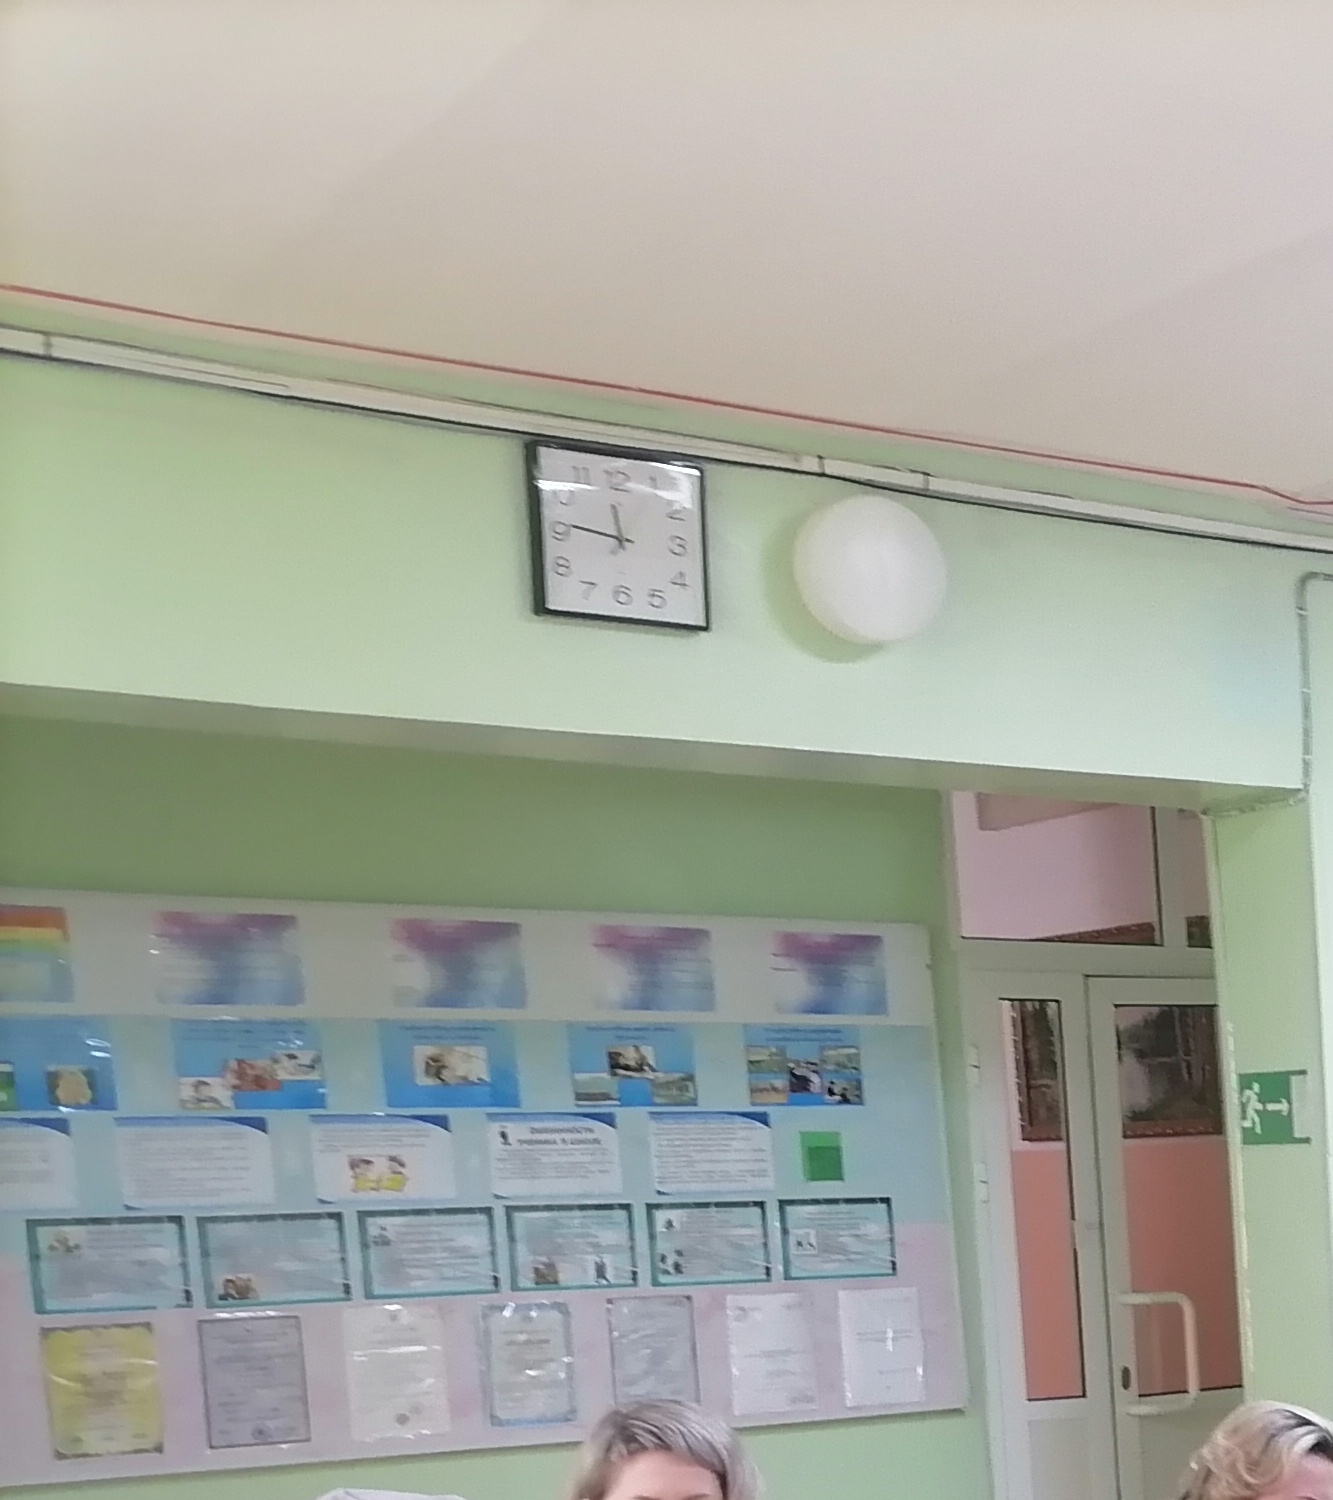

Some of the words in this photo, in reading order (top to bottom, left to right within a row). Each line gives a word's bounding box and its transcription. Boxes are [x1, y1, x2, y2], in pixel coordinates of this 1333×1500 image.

[552, 520, 572, 542] 9
[668, 535, 688, 557] 3
[553, 556, 573, 578] 8
[579, 579, 598, 601] 7
[669, 570, 691, 588] 4
[612, 584, 634, 606] 6
[647, 588, 668, 610] 5
